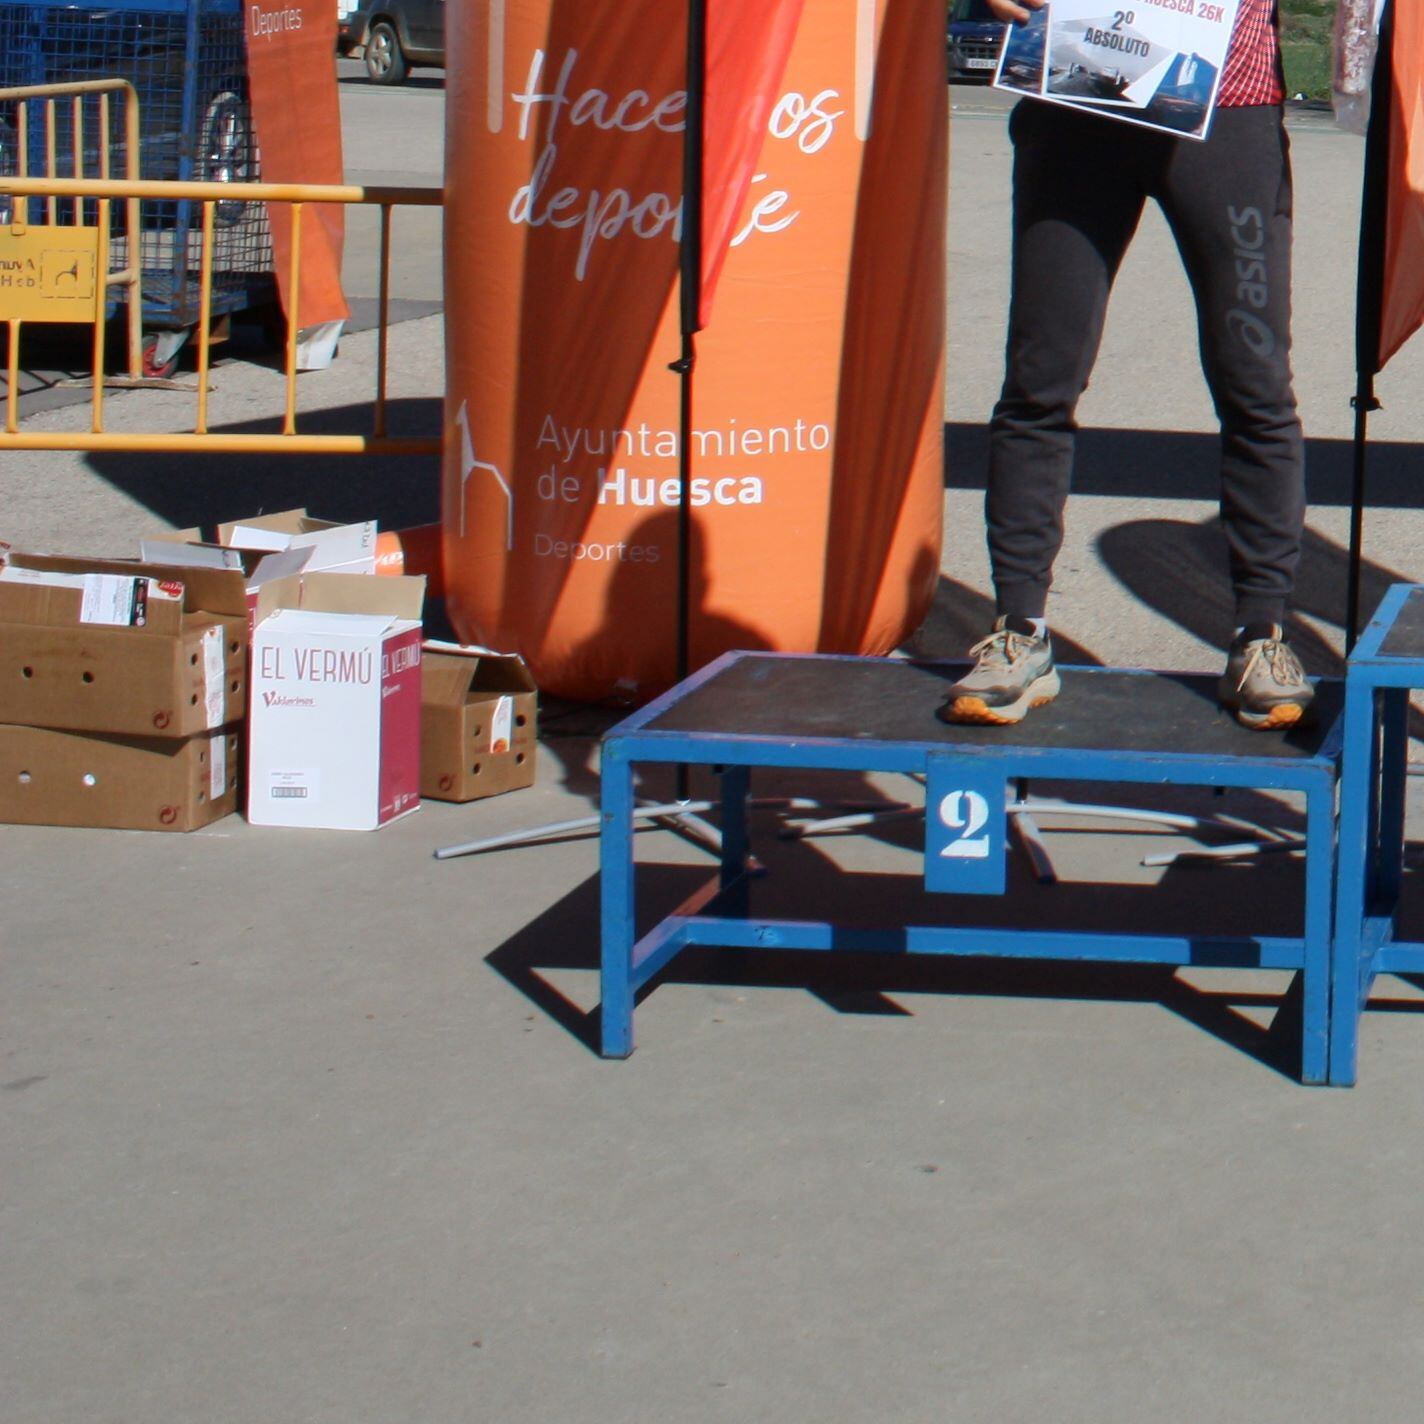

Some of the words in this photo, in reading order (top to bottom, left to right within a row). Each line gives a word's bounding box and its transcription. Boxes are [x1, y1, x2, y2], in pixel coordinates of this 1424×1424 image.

[251, 5, 302, 42] Deportes
[1198, 2, 1225, 23] 26K
[1084, 27, 1151, 58] ABSOLUTO
[511, 47, 845, 154] Haceos
[1227, 205, 1269, 308] asics
[536, 414, 830, 463] Ayuntamiento
[537, 464, 580, 502] de
[598, 467, 763, 506] Huesca
[534, 533, 660, 563] Deportes
[261, 646, 285, 680] EL
[295, 647, 373, 685] VERMÚ
[939, 789, 990, 859] 2
